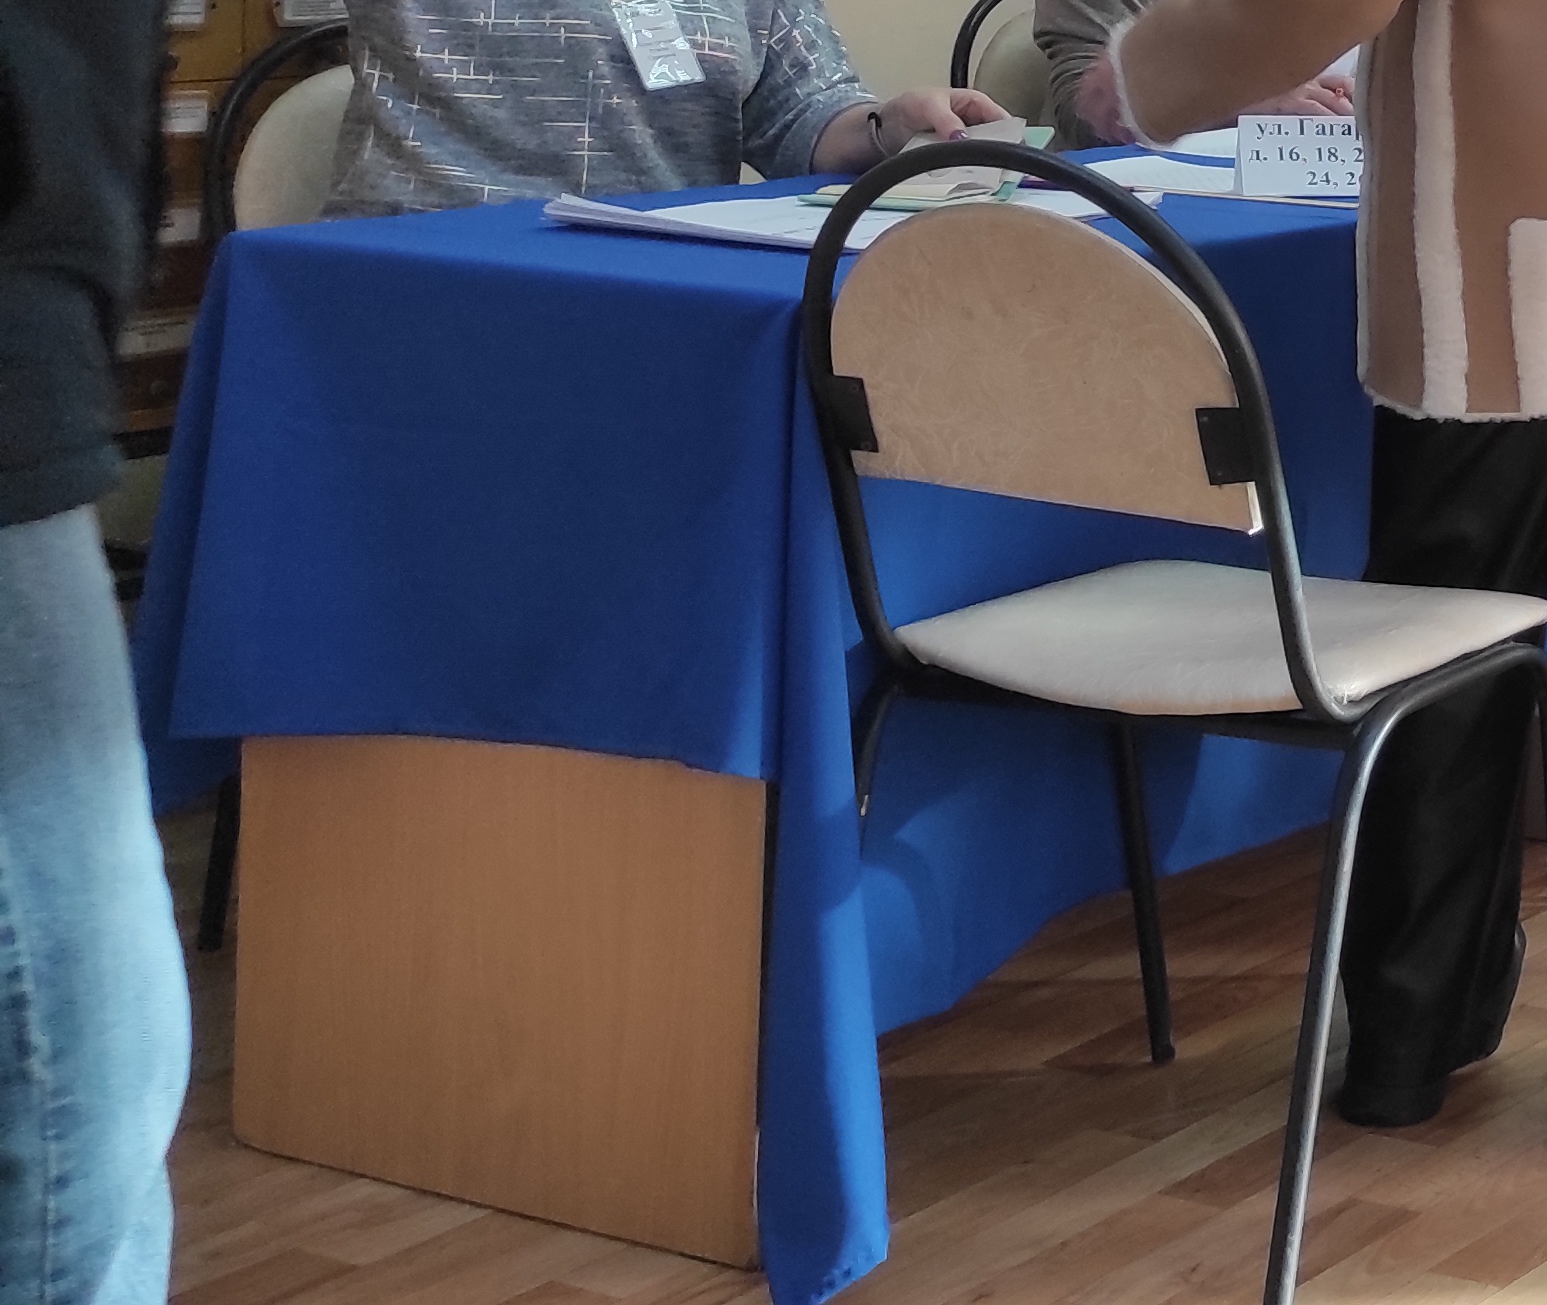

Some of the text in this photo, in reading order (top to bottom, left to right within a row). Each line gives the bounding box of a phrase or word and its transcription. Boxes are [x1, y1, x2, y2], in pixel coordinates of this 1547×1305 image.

[1255, 122, 1290, 140] ул.
[1248, 145, 1364, 166] д. 16, 18, 2
[1305, 170, 1339, 190] 24,
